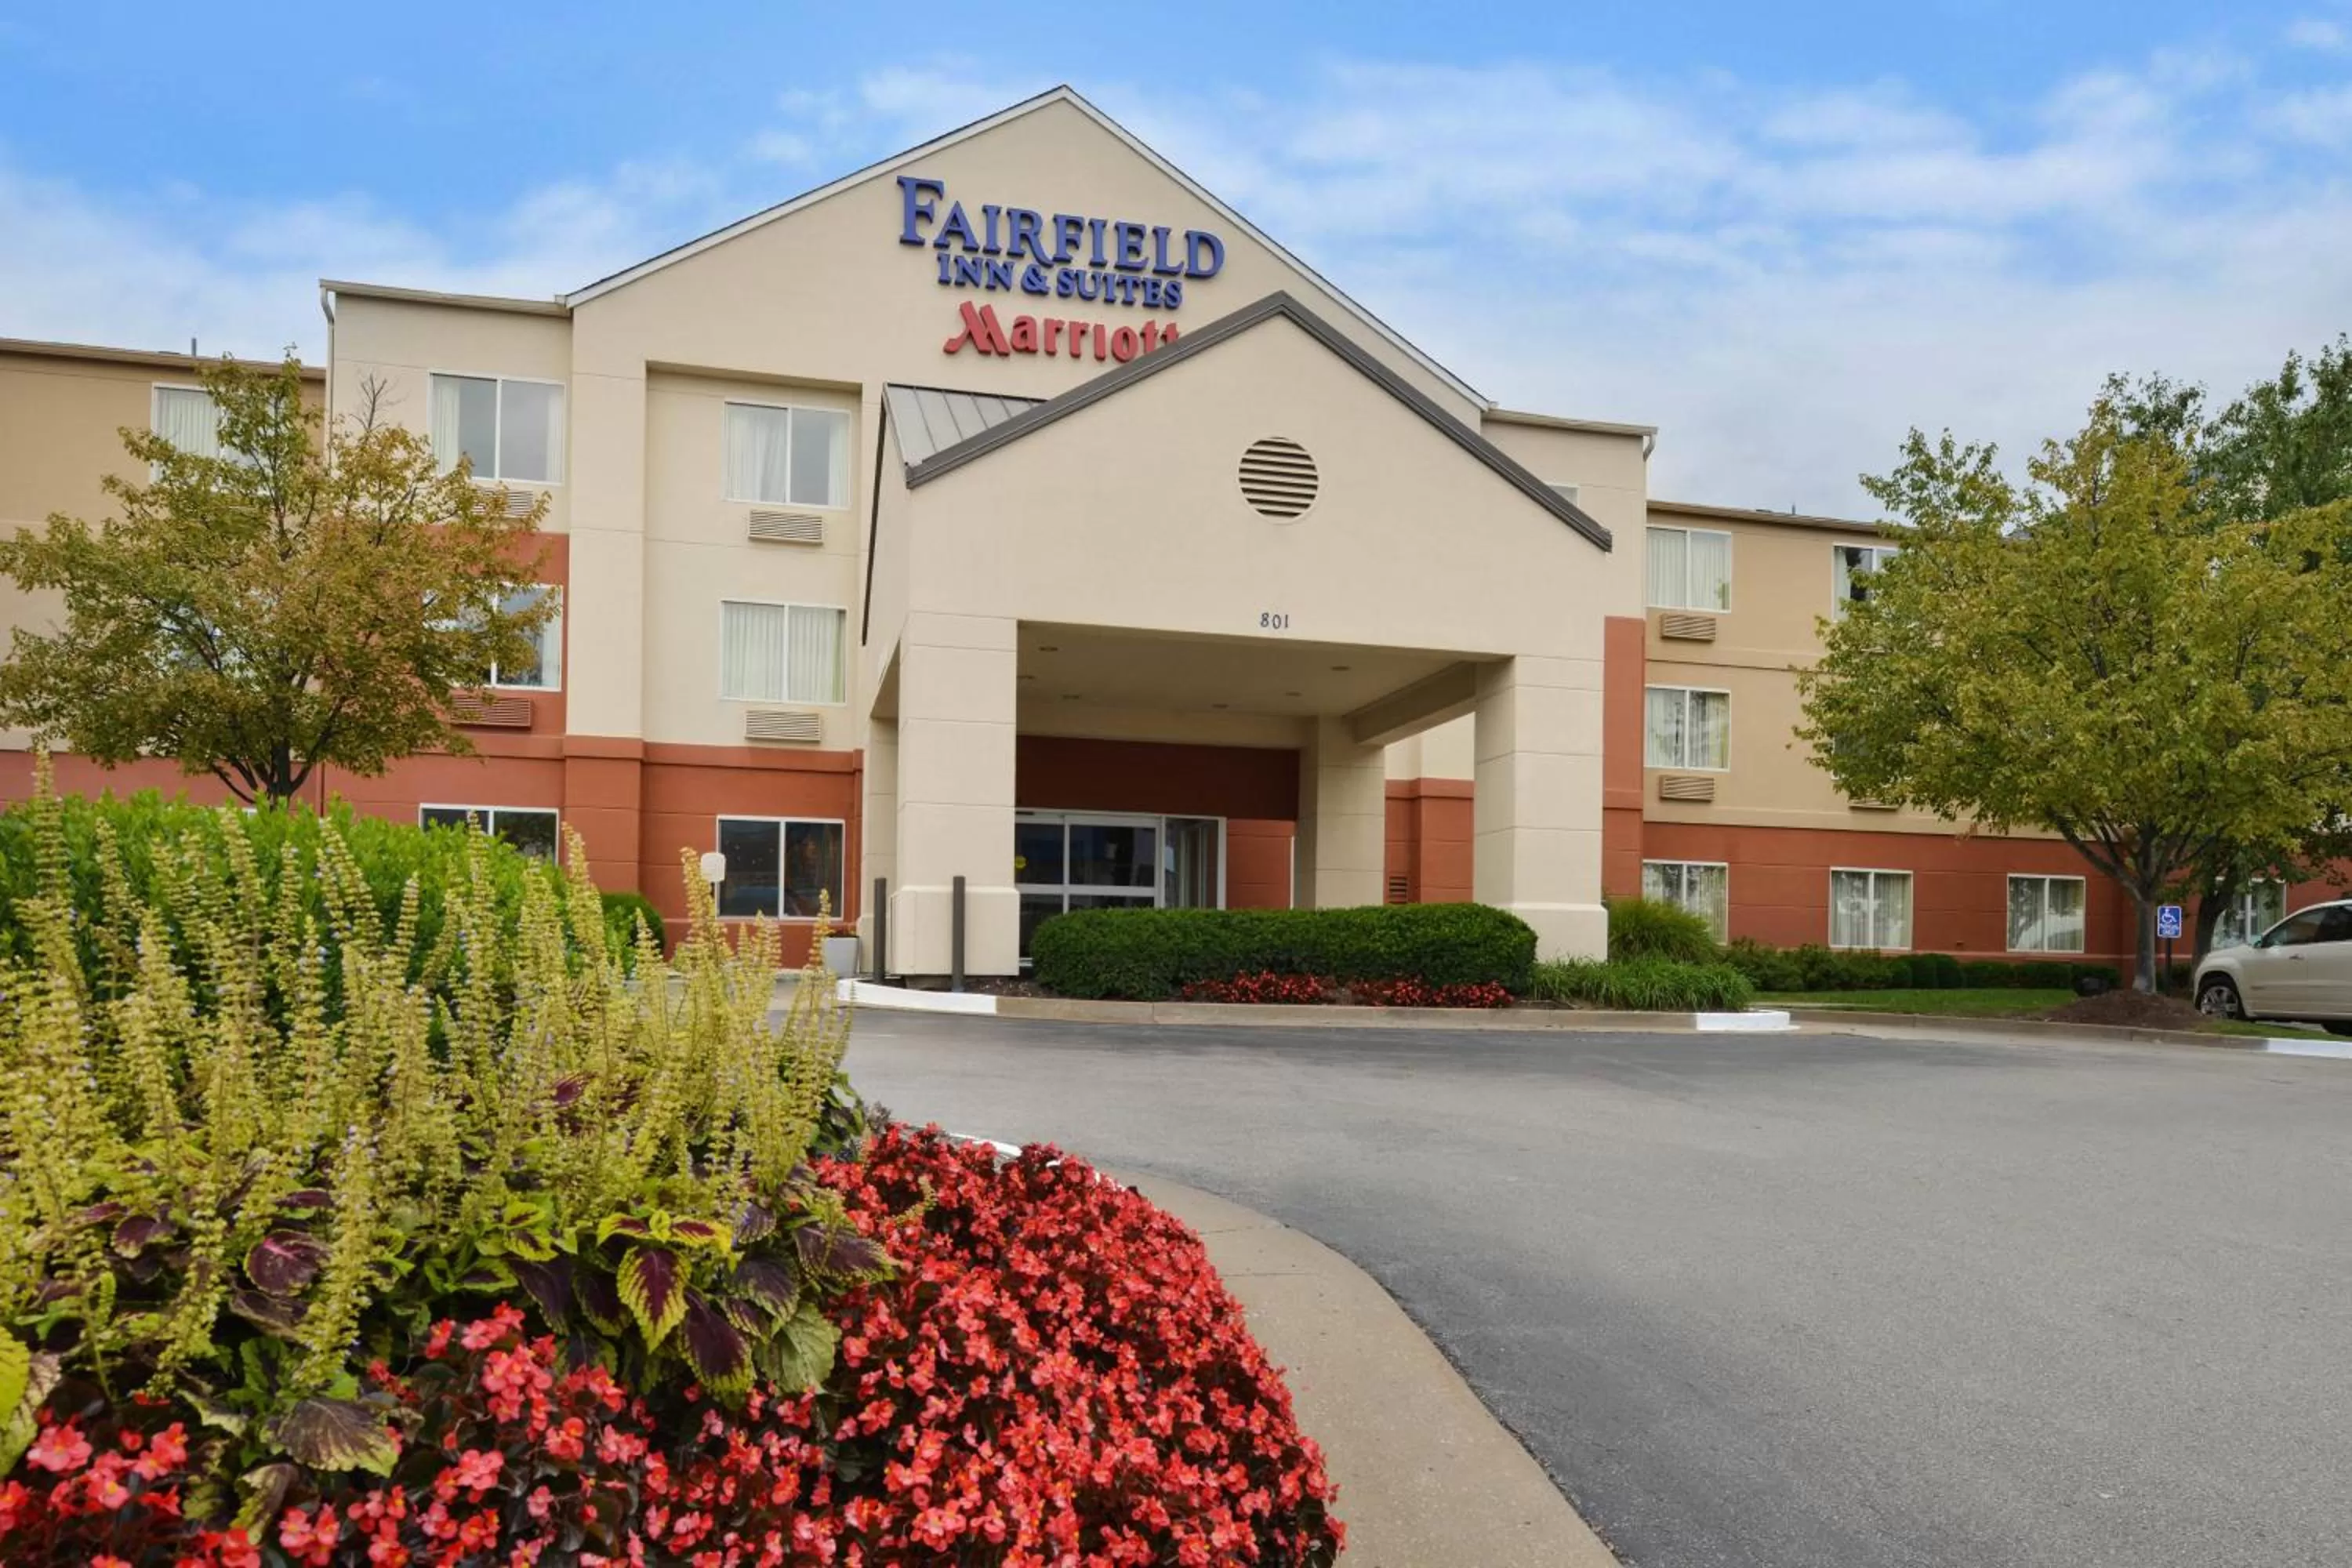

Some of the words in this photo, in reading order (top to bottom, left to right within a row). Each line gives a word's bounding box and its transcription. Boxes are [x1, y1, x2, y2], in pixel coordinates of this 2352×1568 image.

[897, 176, 1225, 279] FAIRFIELD
[937, 252, 1014, 291] INN
[1021, 263, 1050, 296] &
[1057, 267, 1182, 310] SUITES
[1260, 612, 1288, 630] 801
